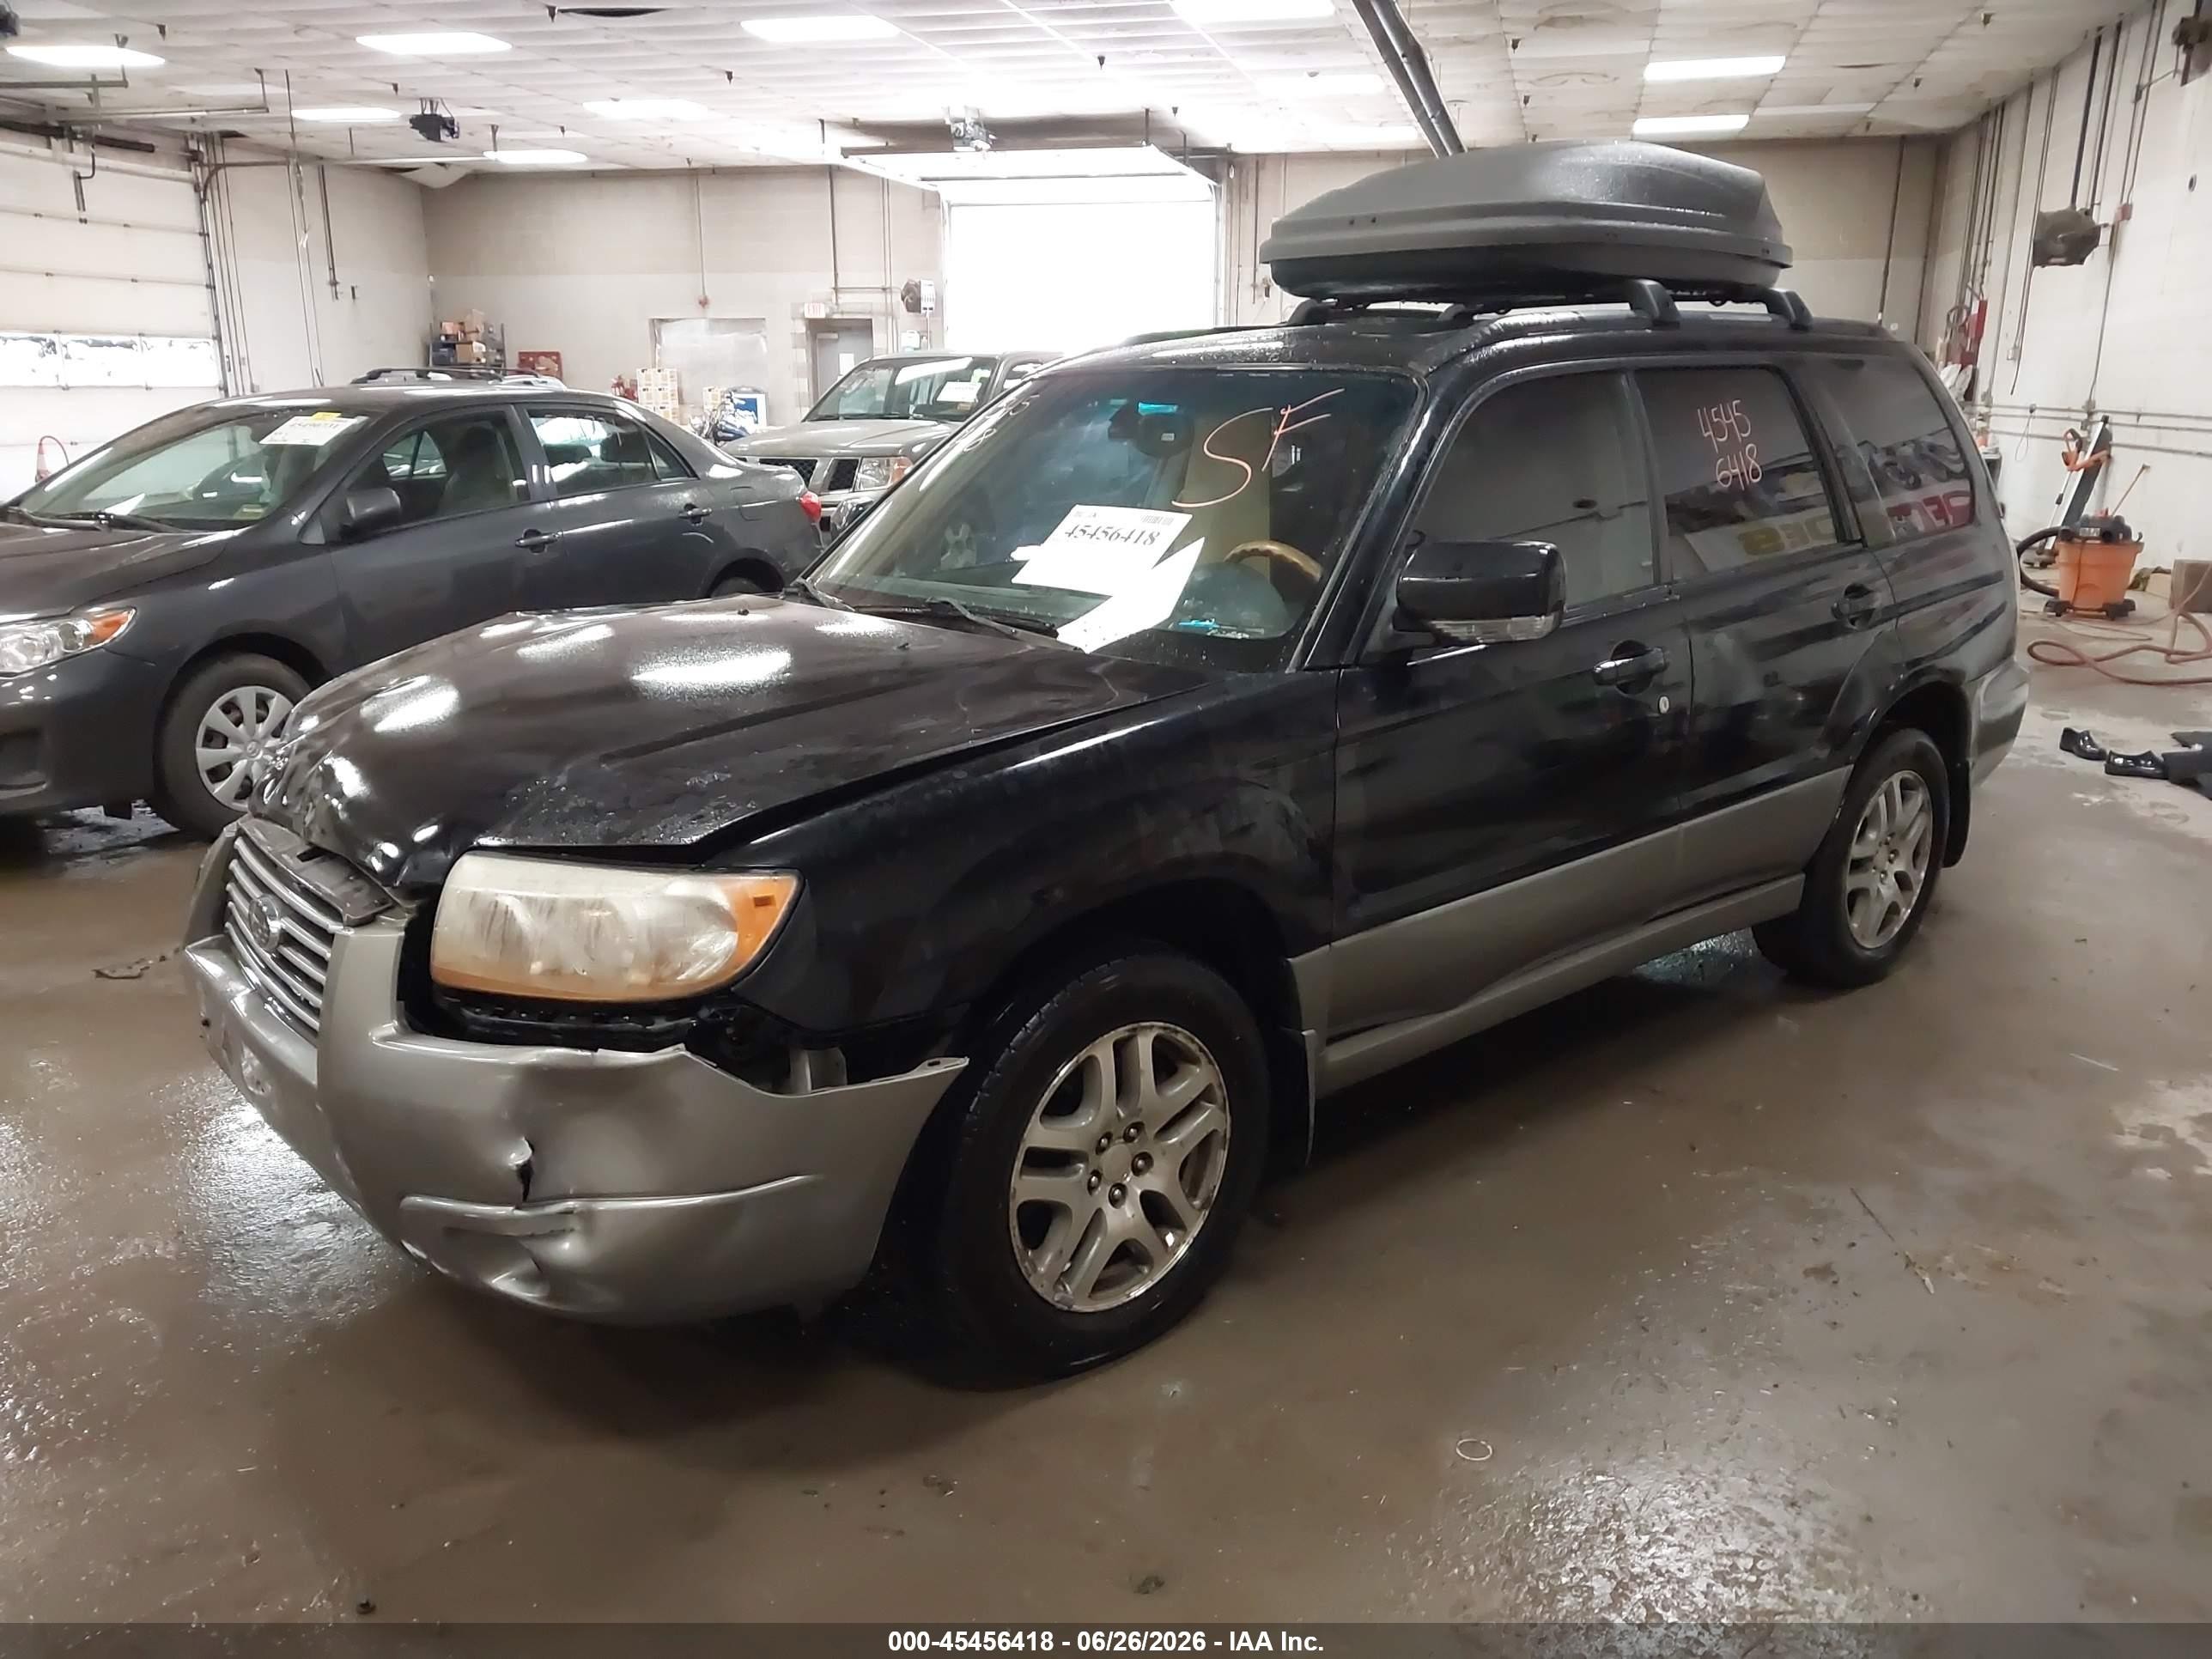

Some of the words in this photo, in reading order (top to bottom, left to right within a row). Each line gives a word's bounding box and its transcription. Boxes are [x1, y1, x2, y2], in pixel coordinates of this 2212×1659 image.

[1171, 387, 1346, 508] SF
[1697, 399, 1751, 453] 4545
[1716, 443, 1762, 491] 6418
[1064, 524, 1161, 546] 45456418
